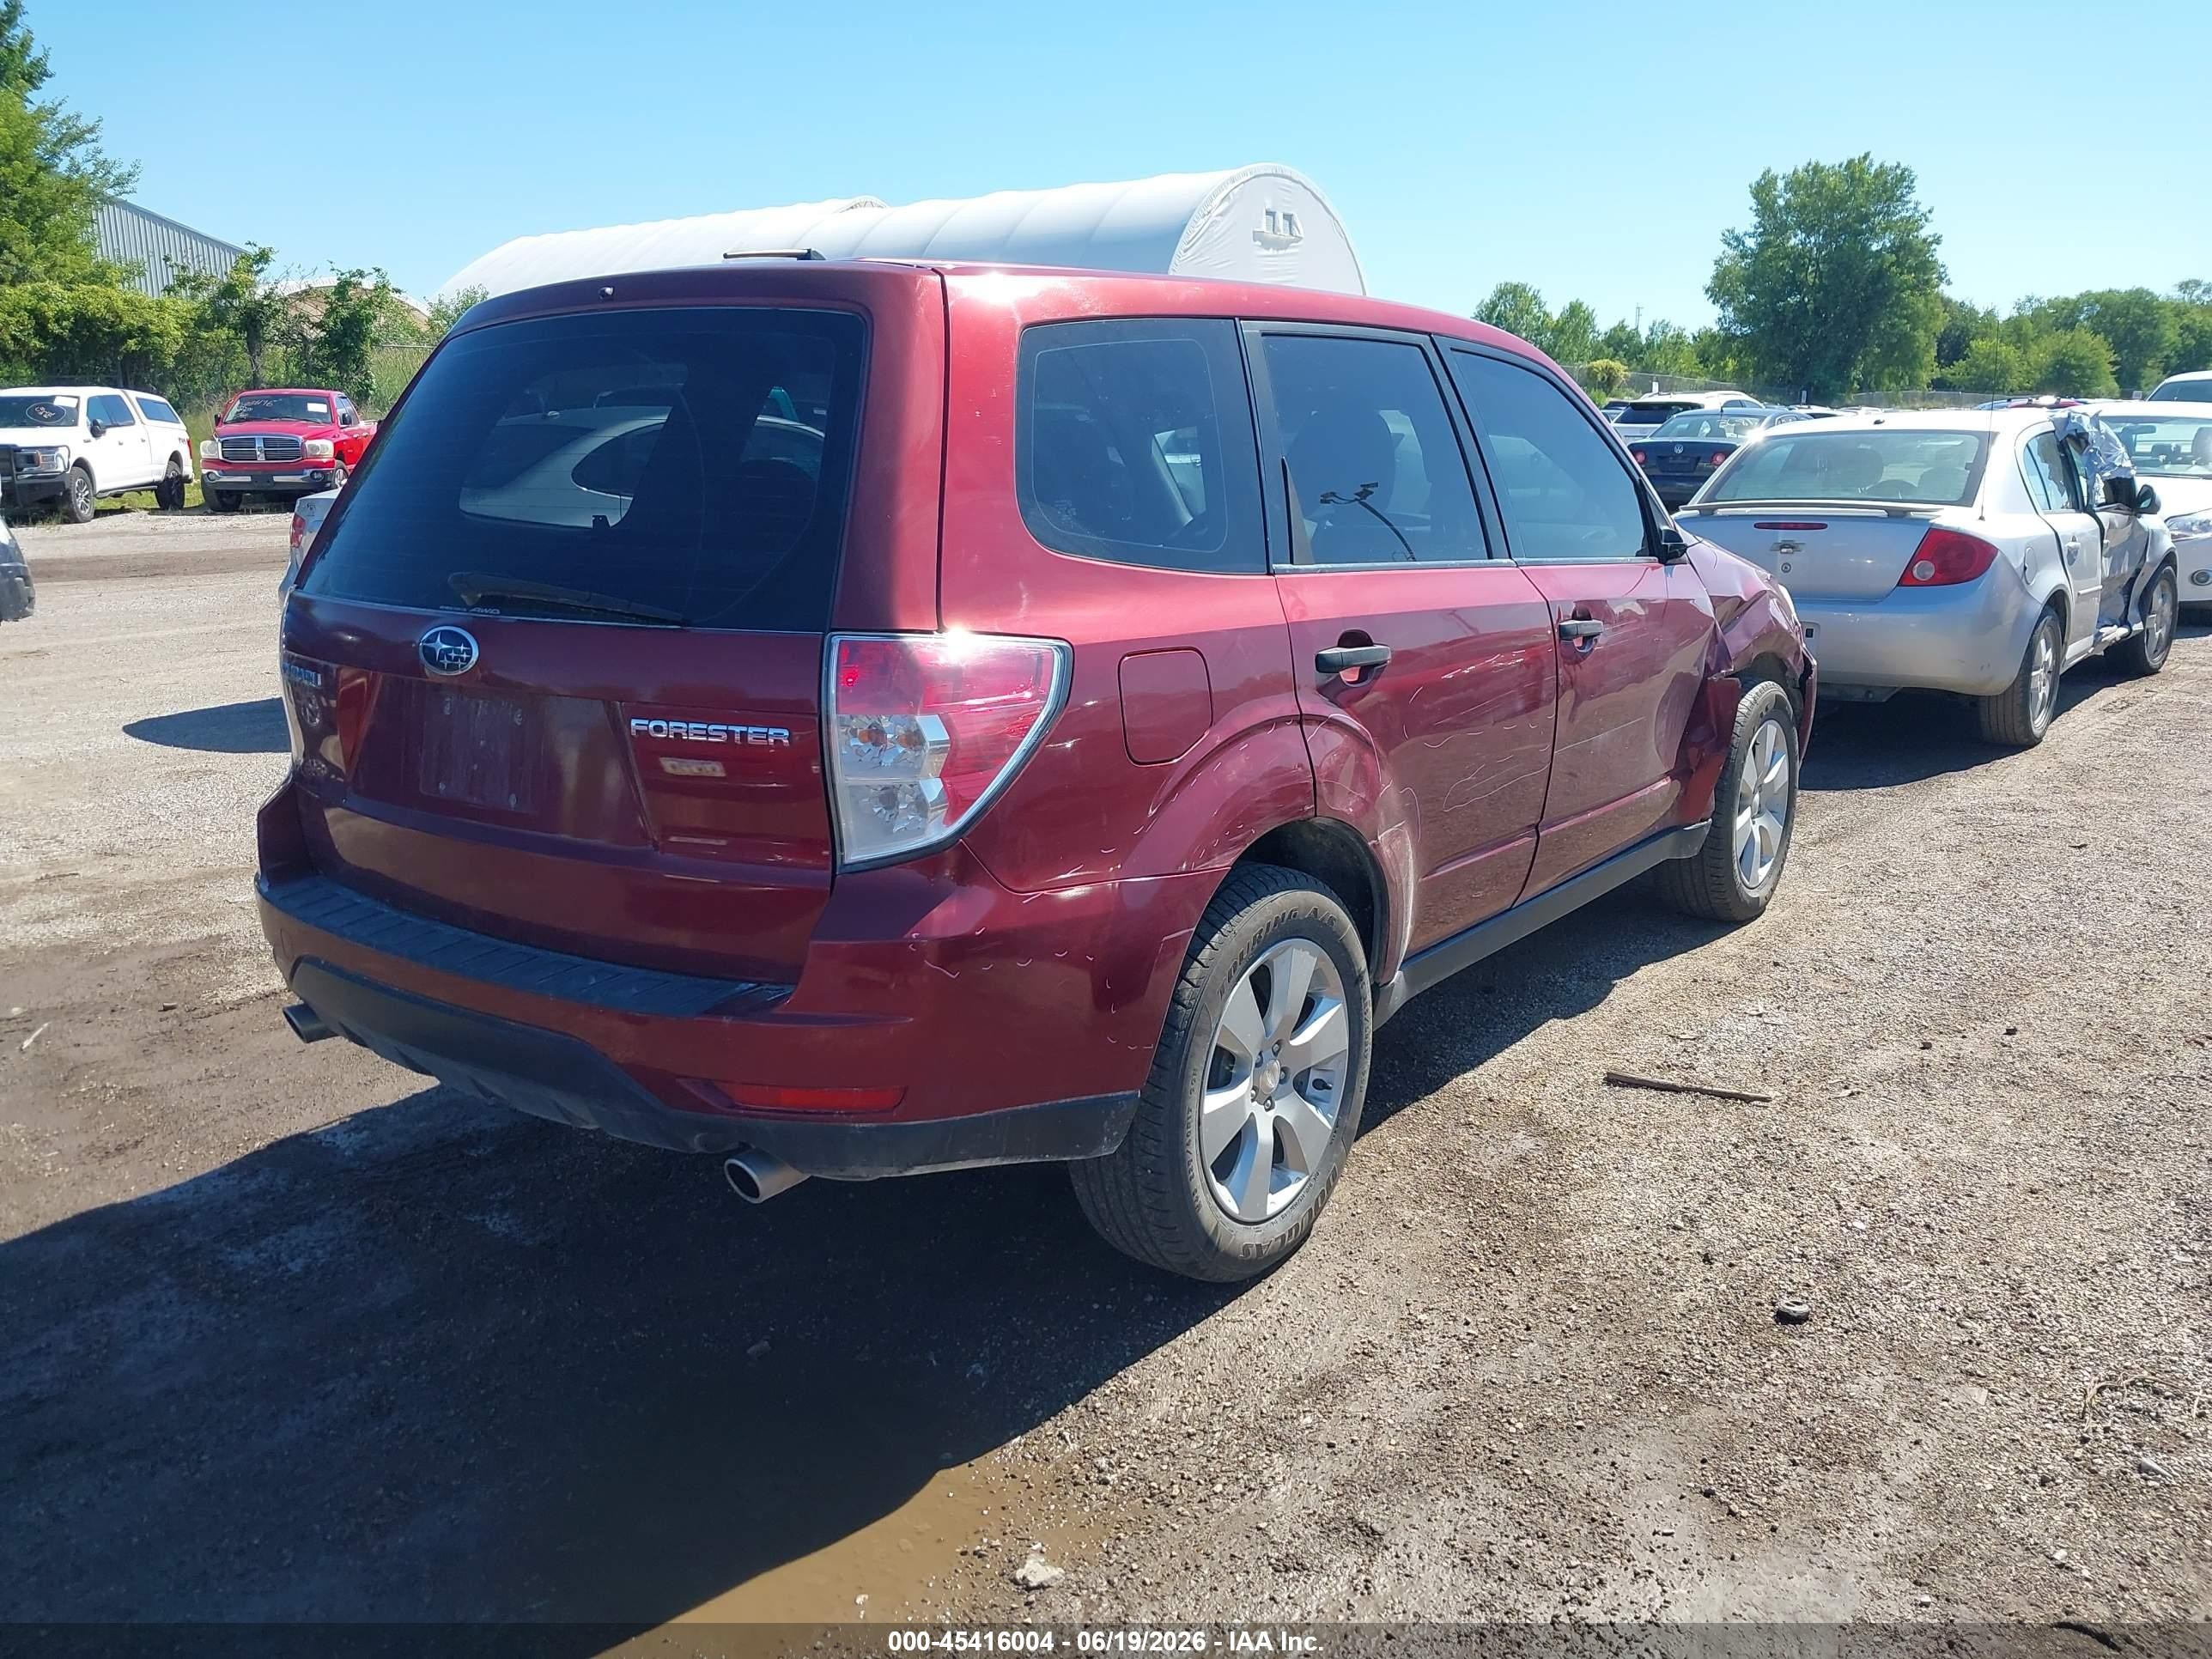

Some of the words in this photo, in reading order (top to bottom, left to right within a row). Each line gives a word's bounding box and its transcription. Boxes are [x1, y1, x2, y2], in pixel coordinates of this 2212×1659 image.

[630, 718, 790, 747] FORESTER
[1217, 906, 1299, 1000] TOURING
[1239, 1163, 1339, 1260] DOUGLAS
